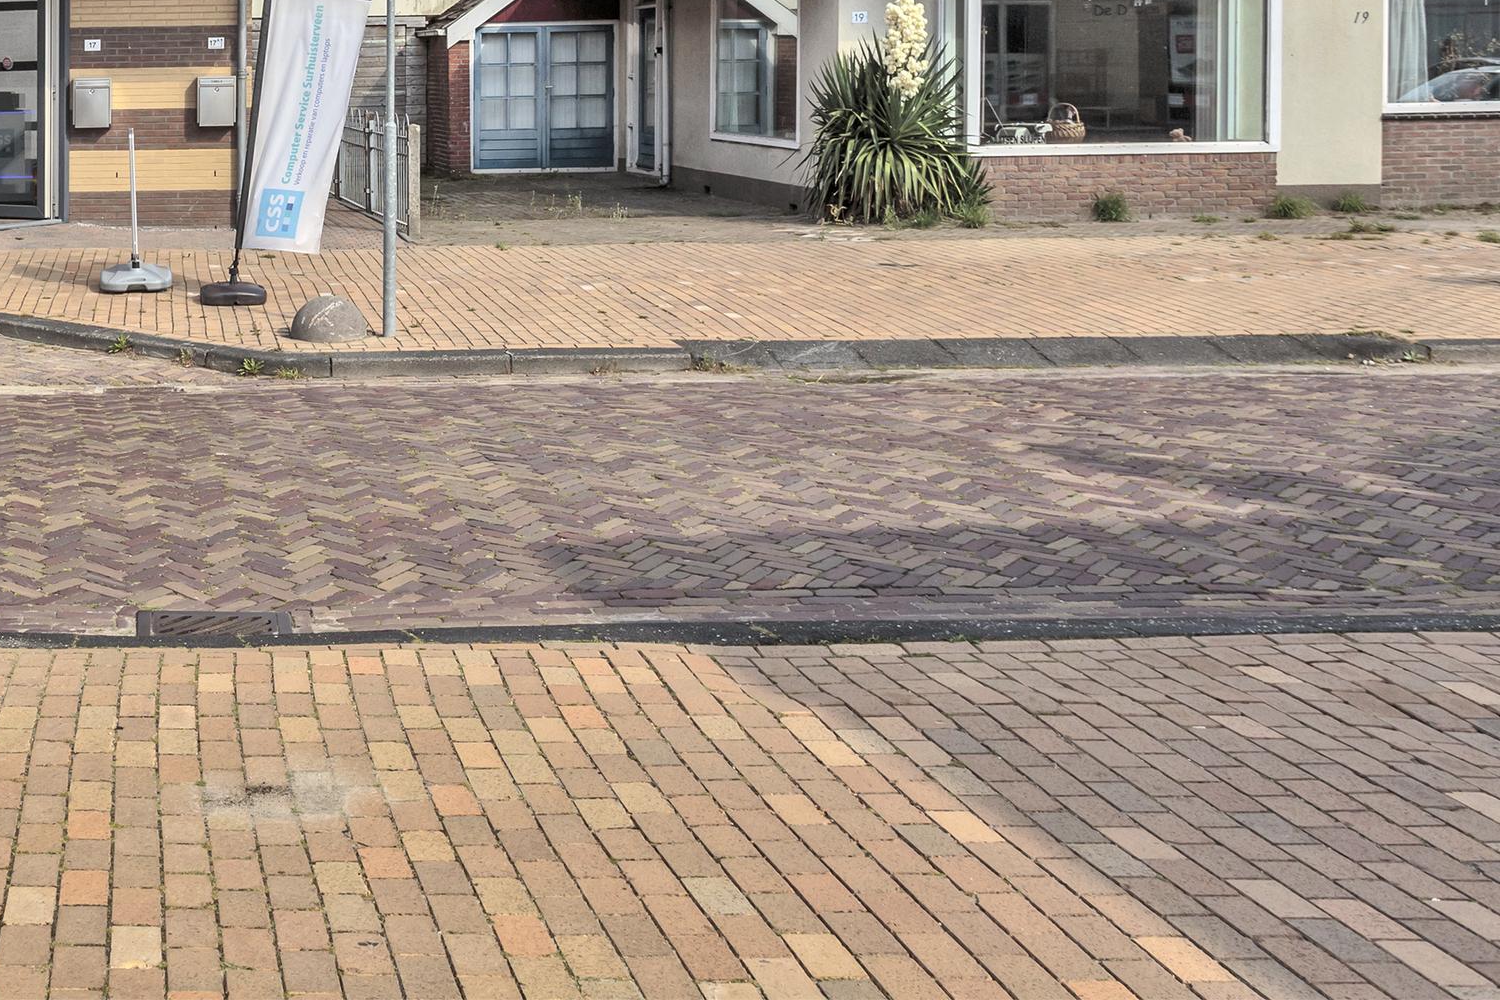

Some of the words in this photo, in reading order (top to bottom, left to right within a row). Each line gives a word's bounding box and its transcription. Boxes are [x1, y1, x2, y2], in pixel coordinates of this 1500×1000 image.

[854, 12, 865, 22] 19
[1353, 11, 1370, 24] 19
[302, 4, 324, 89] Surhuisterveen
[320, 37, 332, 63] laptops
[320, 64, 327, 73] en
[313, 73, 325, 108] computers
[294, 91, 311, 130] Service
[310, 107, 319, 121] van
[304, 121, 316, 150] reparatie
[281, 131, 301, 185] Computer
[302, 150, 309, 159] en
[293, 159, 307, 186] Verkoop
[264, 193, 285, 232] CSS
